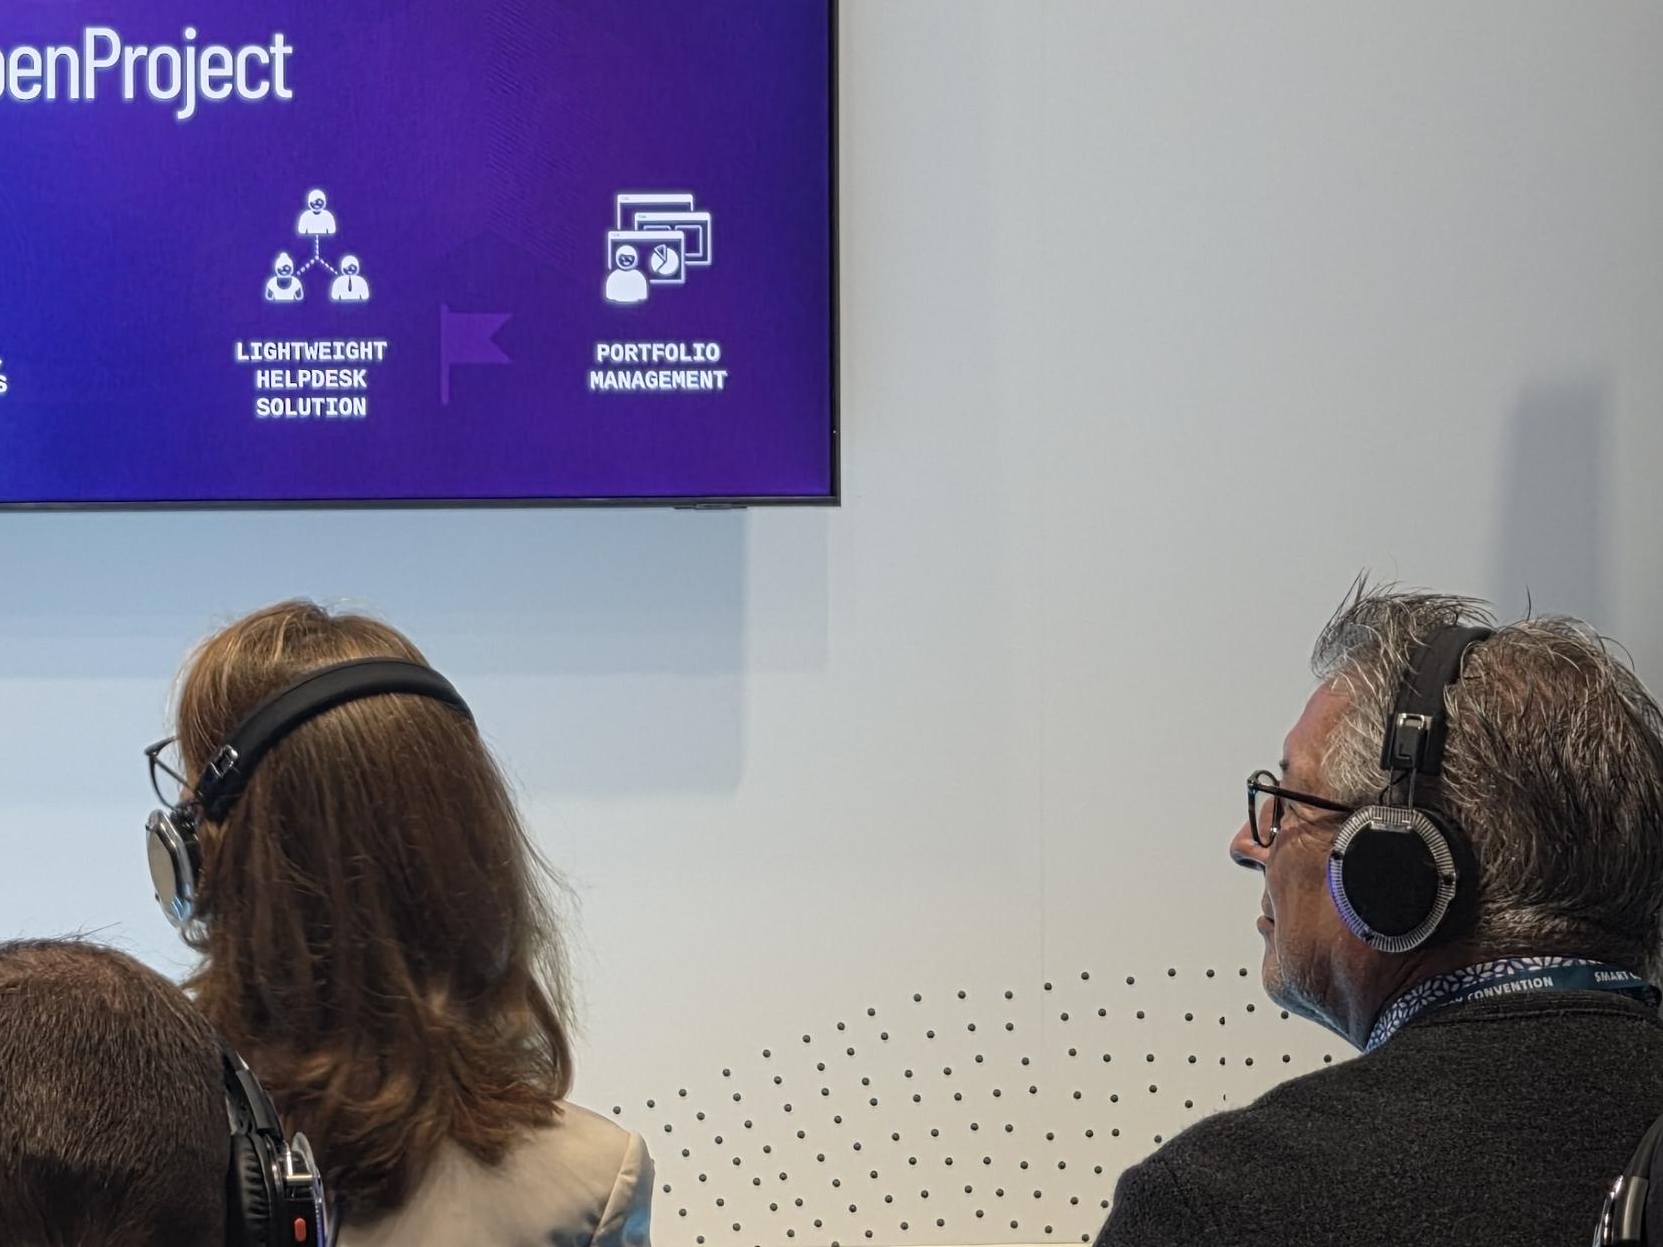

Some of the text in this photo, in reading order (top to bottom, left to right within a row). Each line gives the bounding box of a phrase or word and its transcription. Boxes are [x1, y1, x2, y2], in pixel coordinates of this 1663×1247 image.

[236, 340, 388, 362] LIGHTWEIGHT
[596, 342, 721, 363] PORTFOLIO
[256, 368, 367, 389] HELPDESK
[590, 370, 728, 390] MANAGEMENT
[256, 396, 367, 418] SOLUTION
[1594, 970, 1629, 983] SMART
